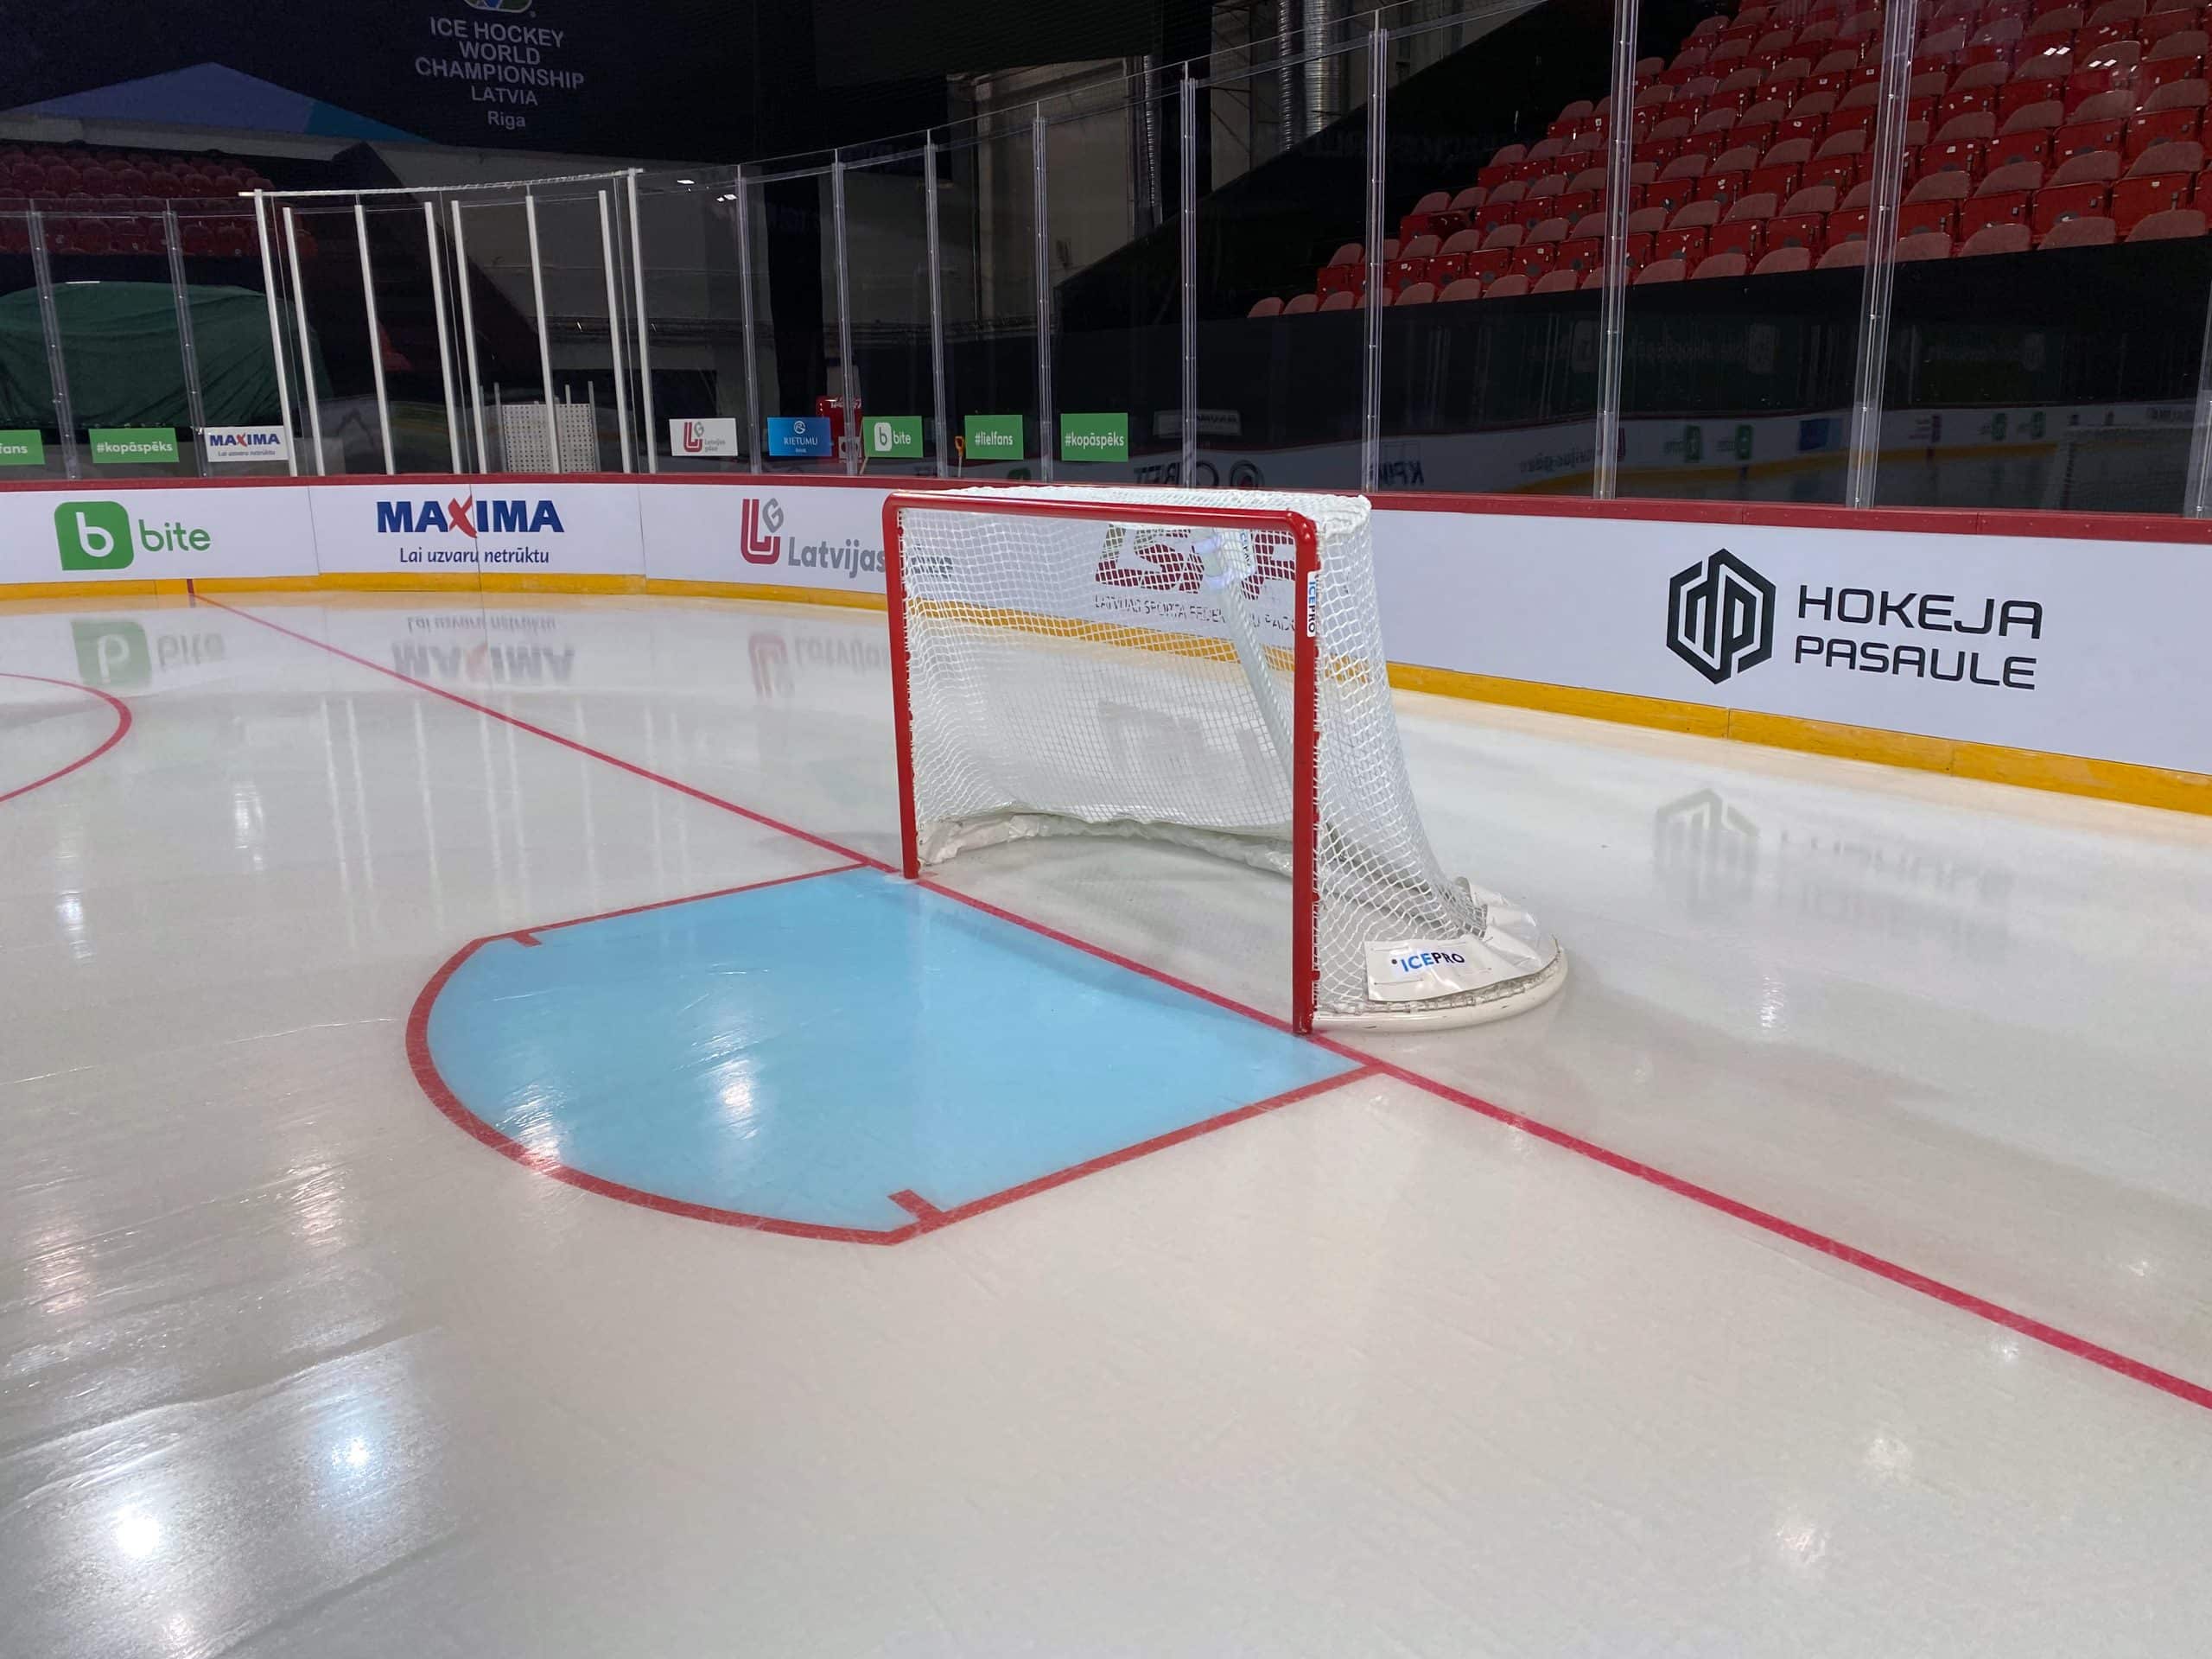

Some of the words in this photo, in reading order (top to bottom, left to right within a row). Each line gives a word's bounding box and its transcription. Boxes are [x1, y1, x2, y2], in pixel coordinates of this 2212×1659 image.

[430, 16, 468, 37] ICE
[474, 22, 564, 48] HOCKEY
[459, 41, 541, 65] WORLD
[415, 56, 585, 89] CHAMPIONSHIP
[471, 86, 538, 105] LATVIA
[487, 111, 526, 130] Riga
[210, 433, 281, 447] MAXIMA
[784, 437, 818, 446] RIETUMU
[893, 430, 912, 445] bite
[975, 431, 1014, 446] #lielfans
[1065, 432, 1124, 449] #kopāspēks
[97, 442, 173, 454] #kopāspēks
[377, 494, 564, 538] MAXIMA
[138, 519, 211, 551] bite
[400, 547, 423, 563] Lai
[427, 549, 480, 563] uzvaru
[484, 547, 550, 564] netrūktu
[788, 537, 886, 578] Latvijas
[1798, 584, 2044, 639] HOKEJA
[1795, 635, 2037, 690] PASAULE
[1400, 951, 1466, 973] ICEPRO
